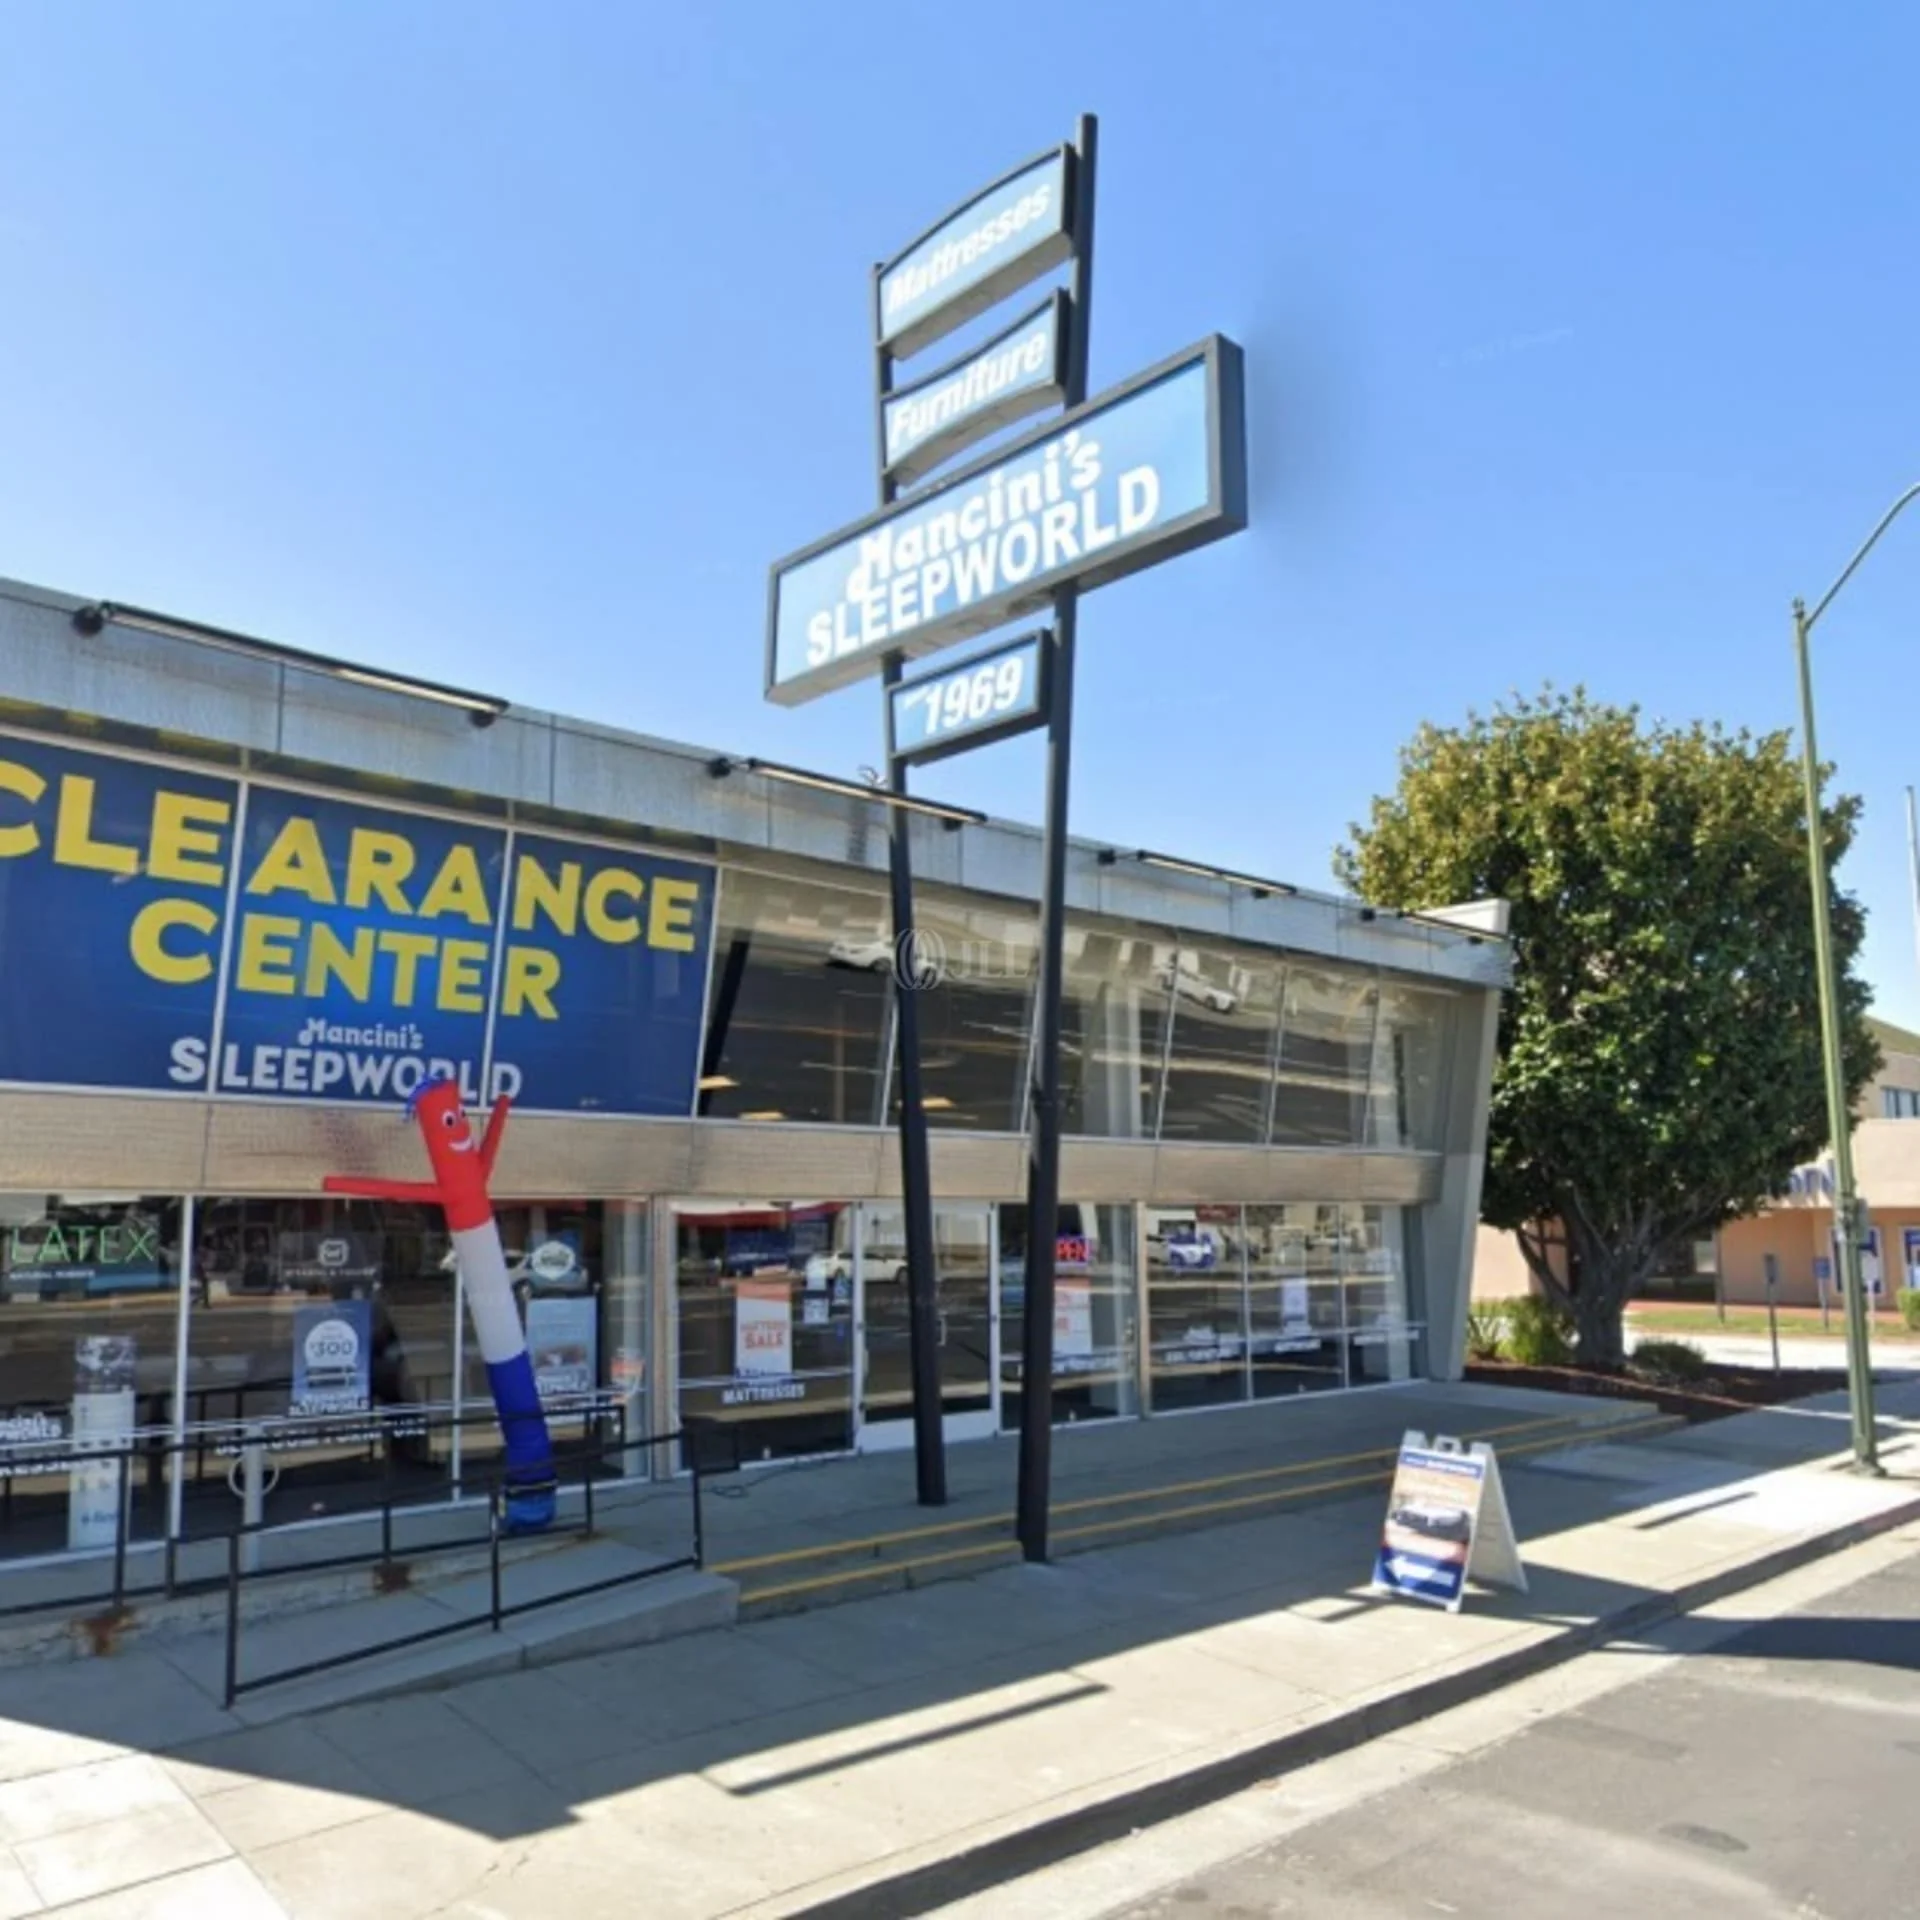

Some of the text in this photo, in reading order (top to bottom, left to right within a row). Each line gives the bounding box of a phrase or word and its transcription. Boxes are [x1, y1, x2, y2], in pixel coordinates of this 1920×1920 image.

[886, 183, 1051, 314] Mattresses
[887, 331, 1046, 450] Furniture
[806, 465, 1160, 667] SLEEPWORLD
[845, 429, 1101, 602] Mancini's
[924, 656, 1023, 736] 1969
[130, 898, 561, 1020] CENTER
[297, 1017, 423, 1050] Mancini's
[11, 1225, 155, 1264] LATEX
